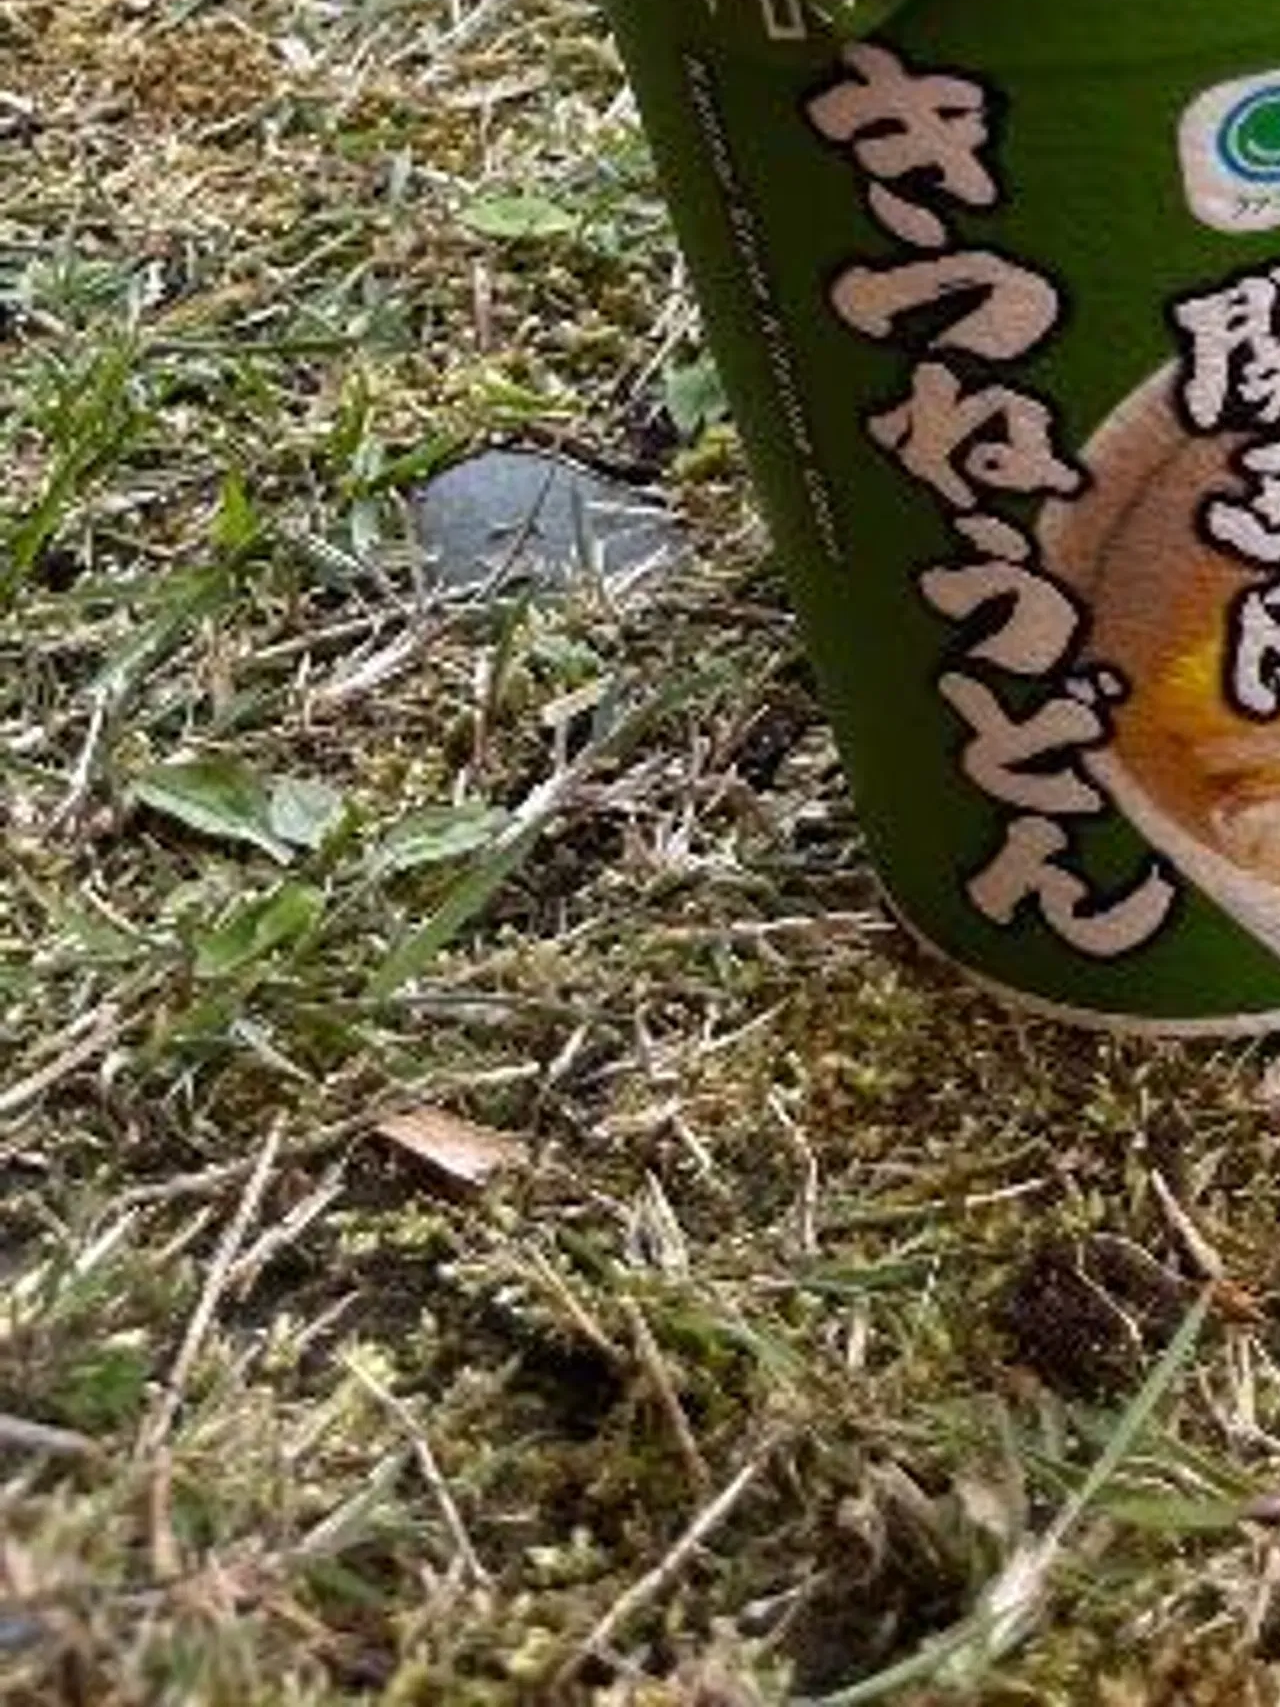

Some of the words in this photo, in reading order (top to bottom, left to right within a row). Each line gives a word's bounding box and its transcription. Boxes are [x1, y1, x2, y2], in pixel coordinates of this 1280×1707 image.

[806, 42, 1176, 957] きつねうどん
